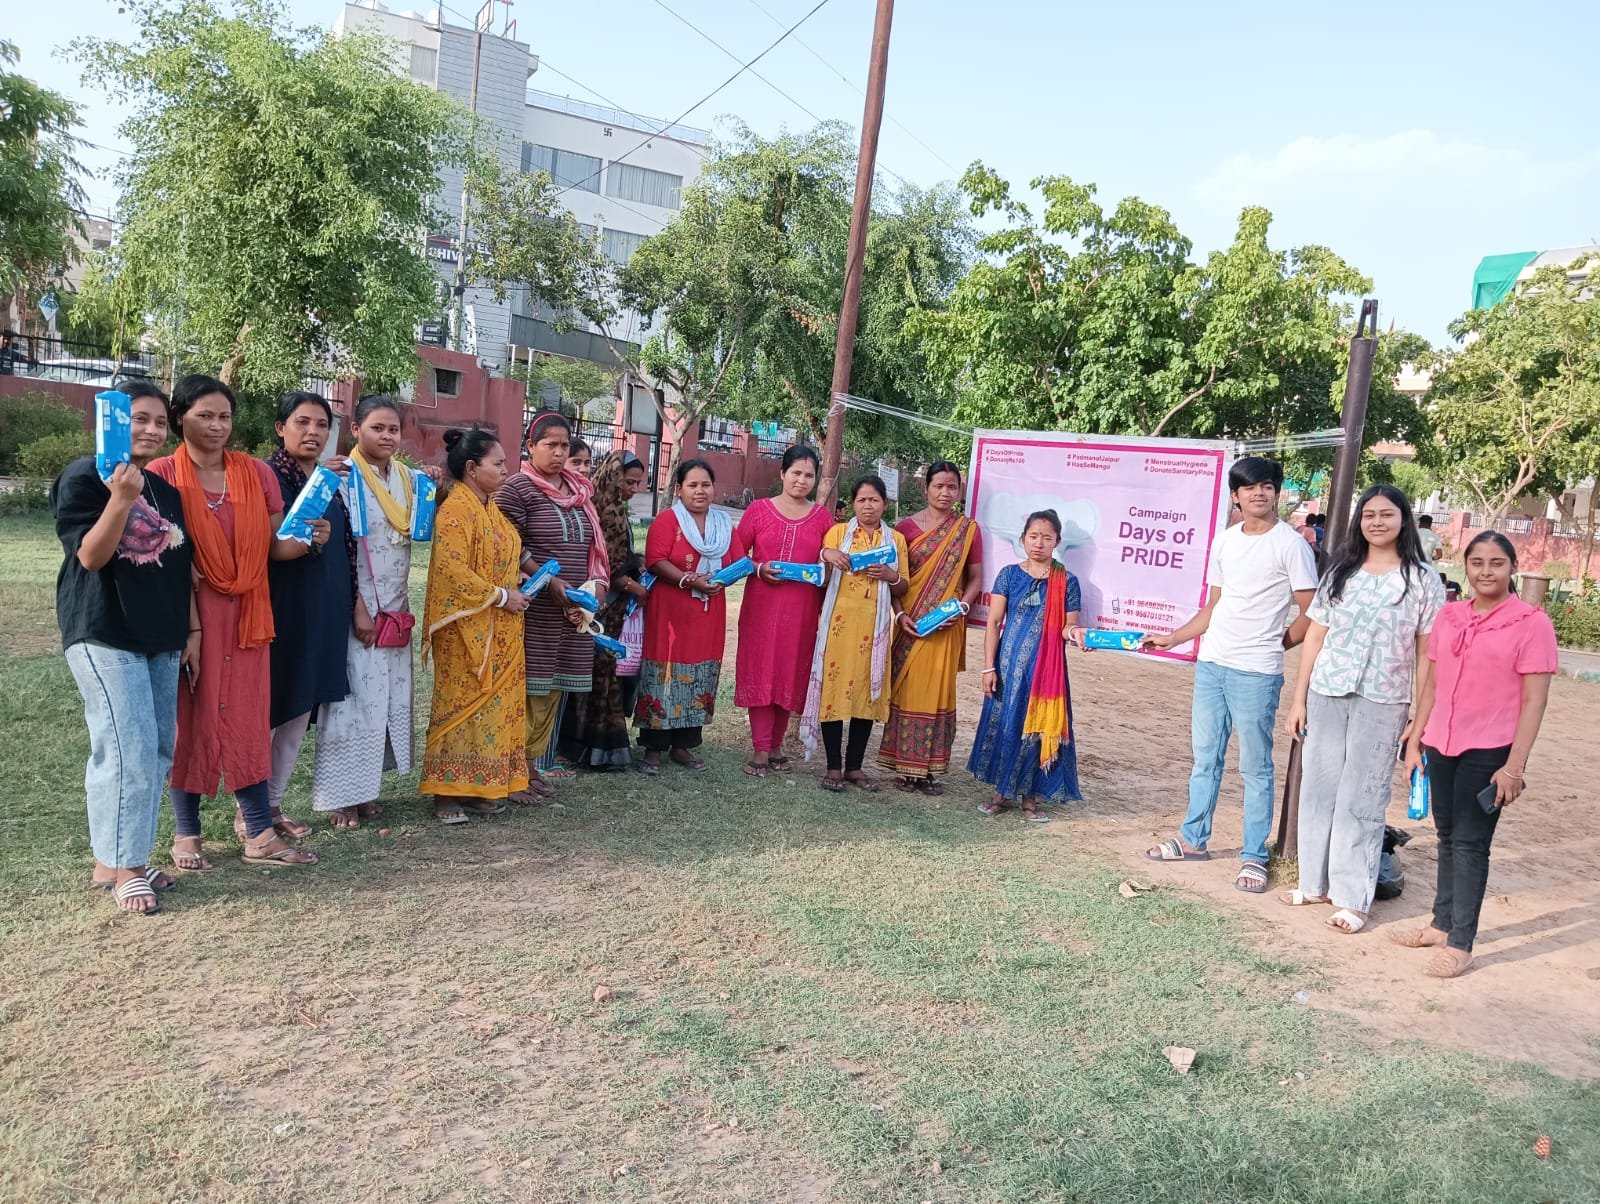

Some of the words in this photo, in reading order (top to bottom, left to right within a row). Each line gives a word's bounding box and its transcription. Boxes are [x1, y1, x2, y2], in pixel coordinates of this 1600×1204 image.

[1128, 506, 1187, 523] Campaign
[1118, 521, 1167, 545] Days
[1172, 527, 1196, 545] of
[1120, 545, 1185, 569] PRIDE
[1096, 615, 1119, 625] Website
